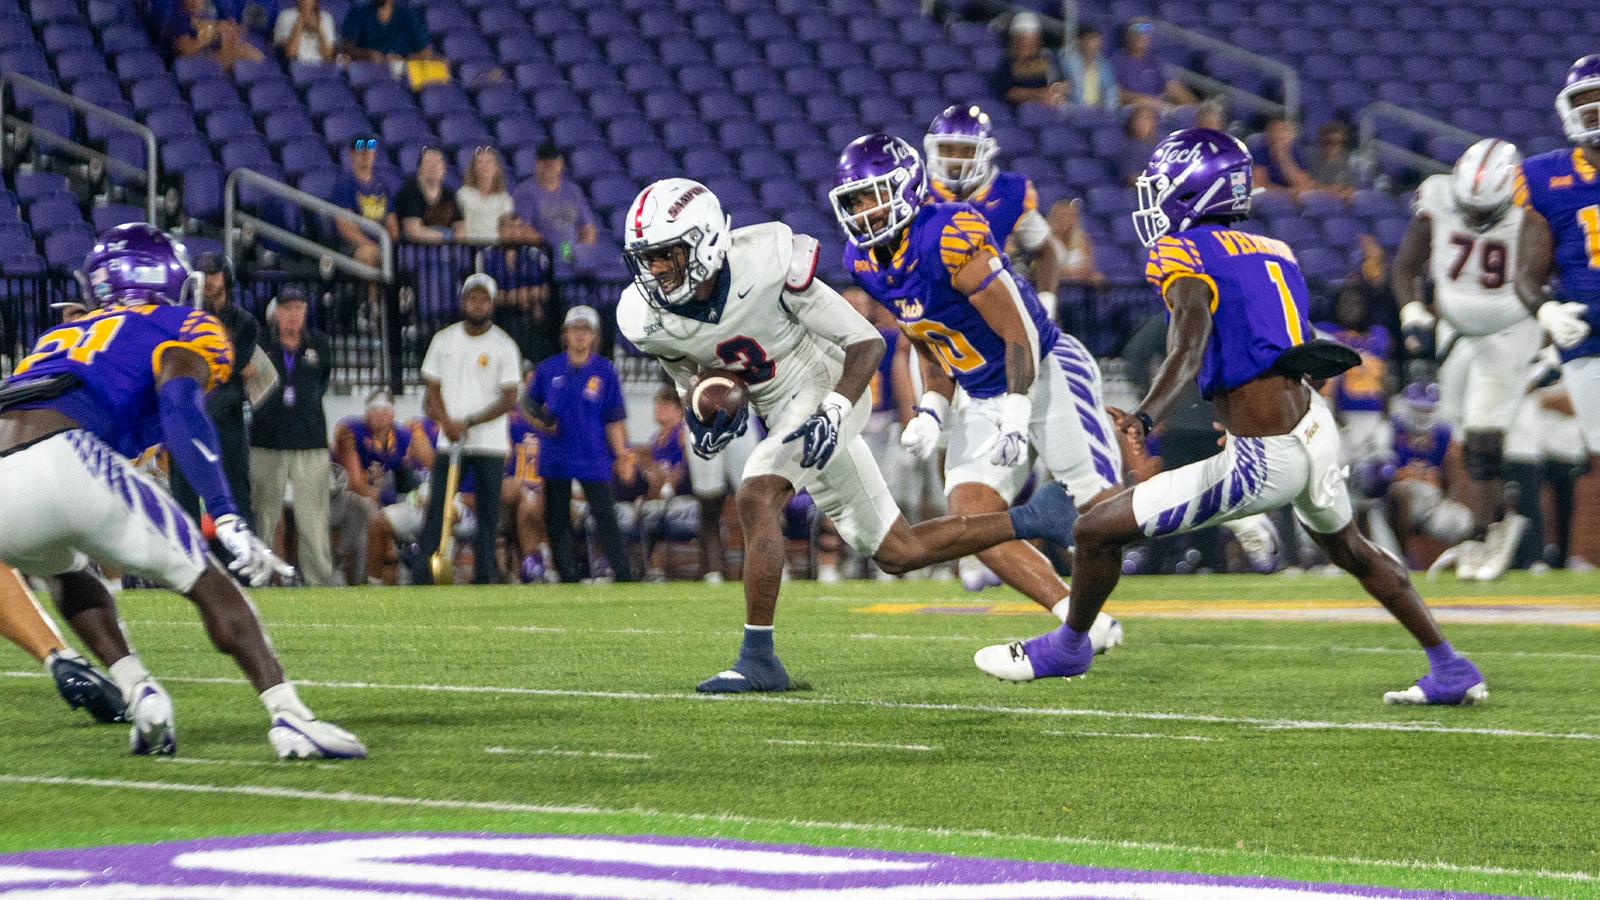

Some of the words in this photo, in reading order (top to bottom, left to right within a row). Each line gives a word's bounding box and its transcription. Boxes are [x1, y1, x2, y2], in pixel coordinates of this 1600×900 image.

[1150, 141, 1204, 168] Tech
[1449, 231, 1507, 289] 79
[894, 297, 924, 319] Tech
[1264, 260, 1304, 347] 1
[716, 335, 776, 386] 3
